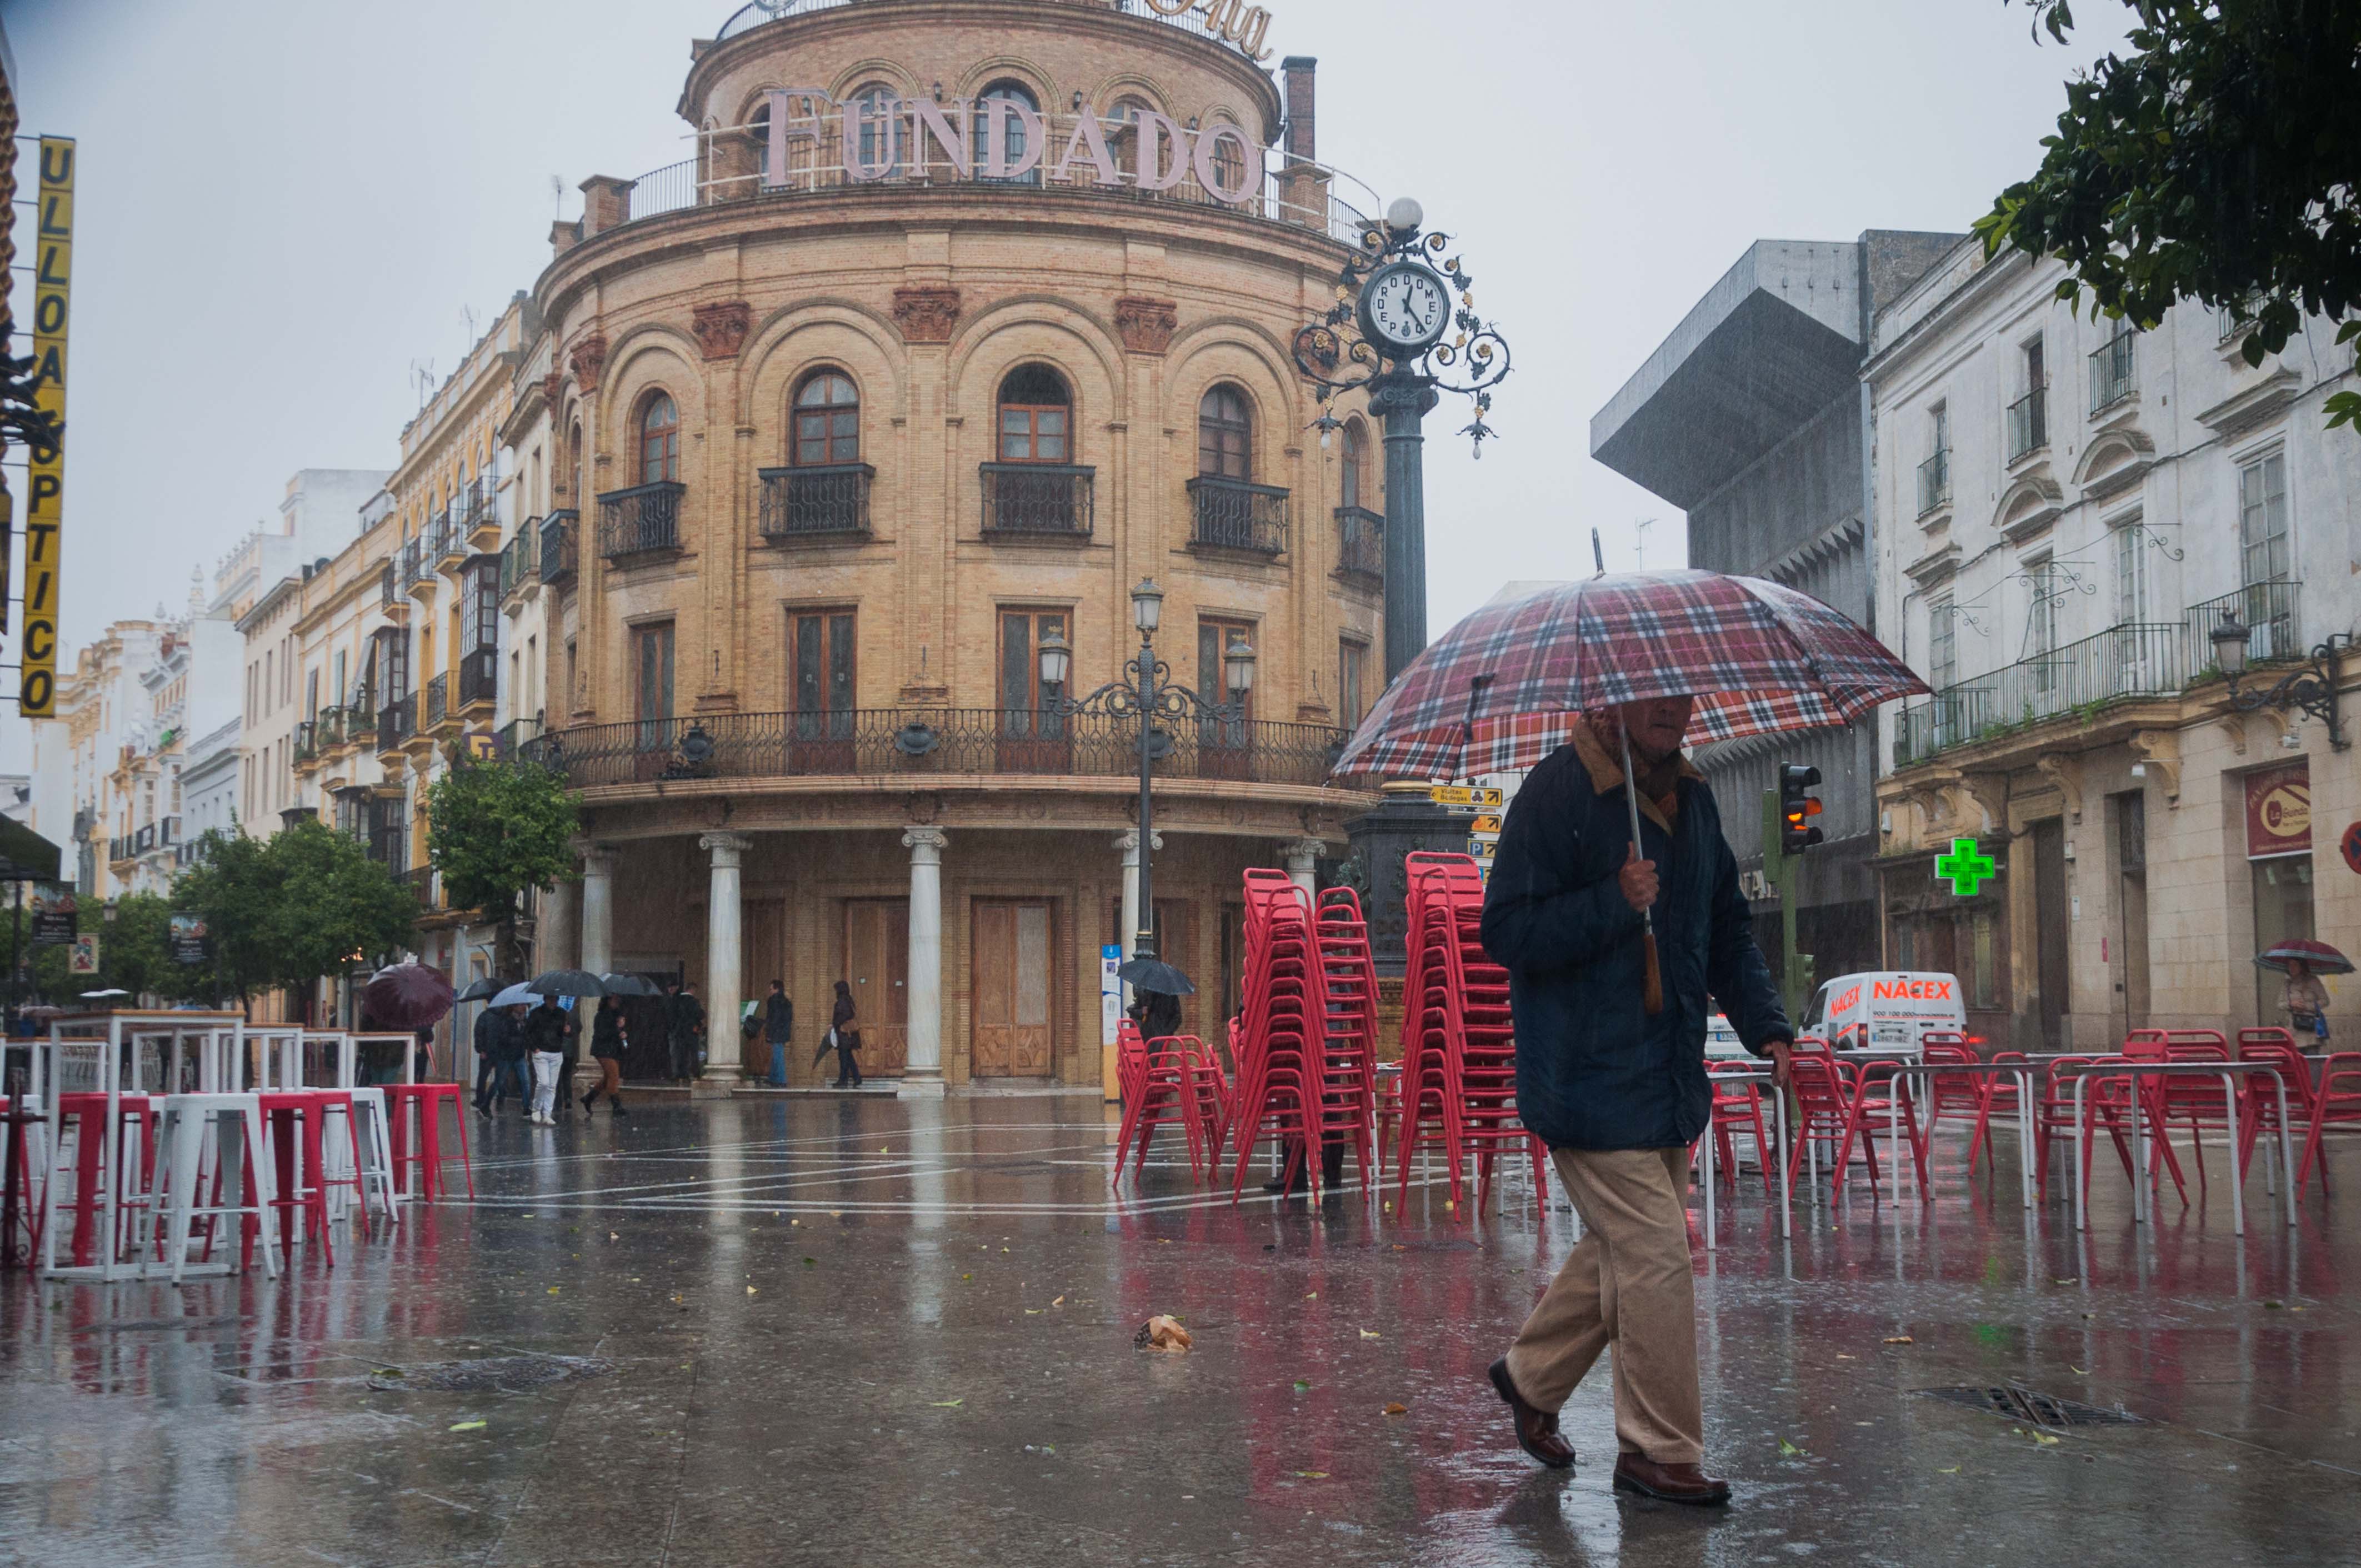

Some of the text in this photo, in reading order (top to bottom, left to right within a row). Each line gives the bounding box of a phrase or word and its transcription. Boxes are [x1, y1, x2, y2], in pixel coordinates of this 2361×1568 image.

[38, 146, 72, 384] ULLOA
[1829, 983, 1862, 1019] NACEX
[1873, 980, 1952, 1000] NACEX
